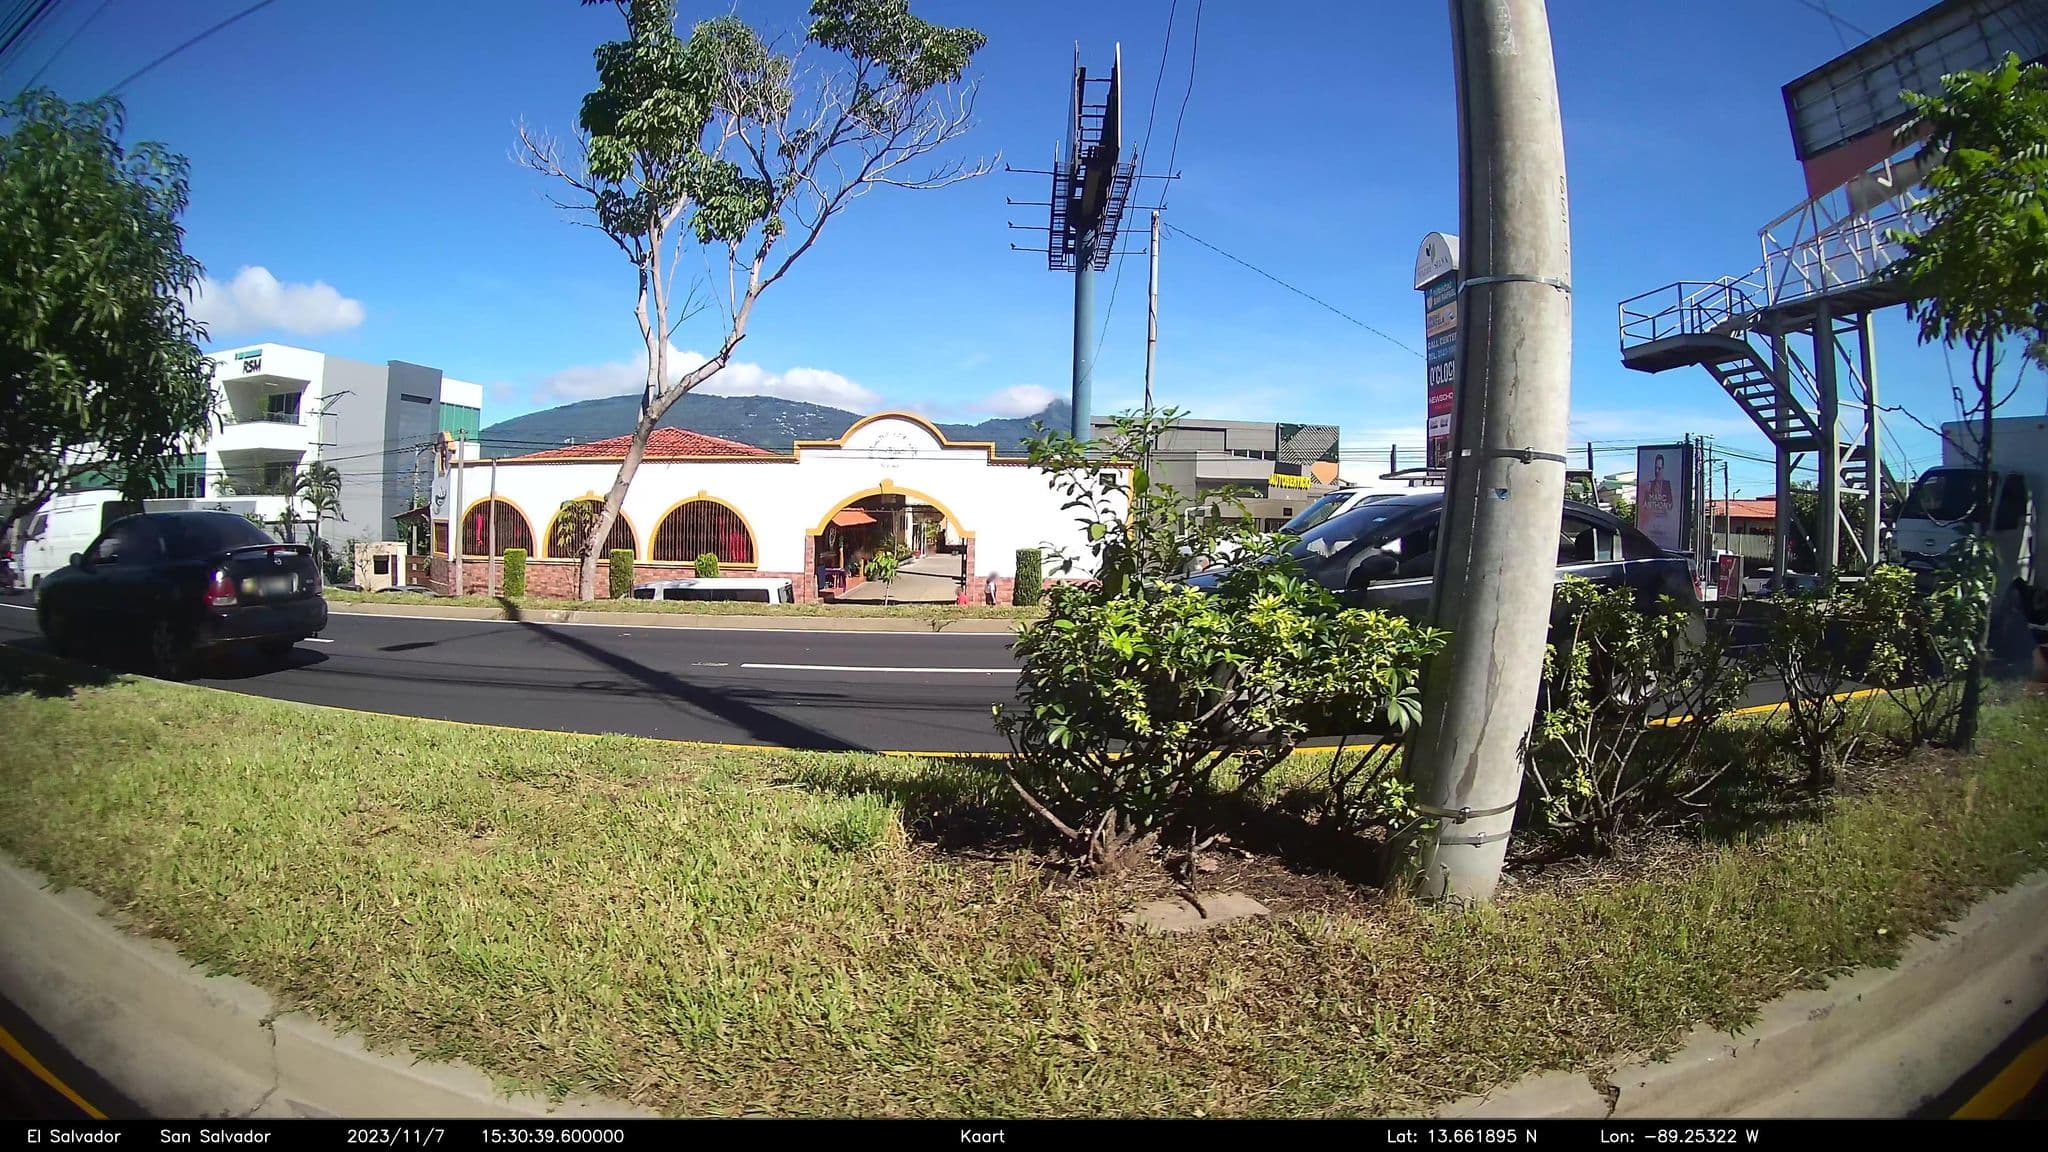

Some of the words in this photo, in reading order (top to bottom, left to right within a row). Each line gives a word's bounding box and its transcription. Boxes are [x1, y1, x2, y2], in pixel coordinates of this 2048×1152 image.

[242, 358, 262, 374] RSM
[1648, 494, 1667, 502] MARC
[1643, 500, 1673, 510] ANTHONY
